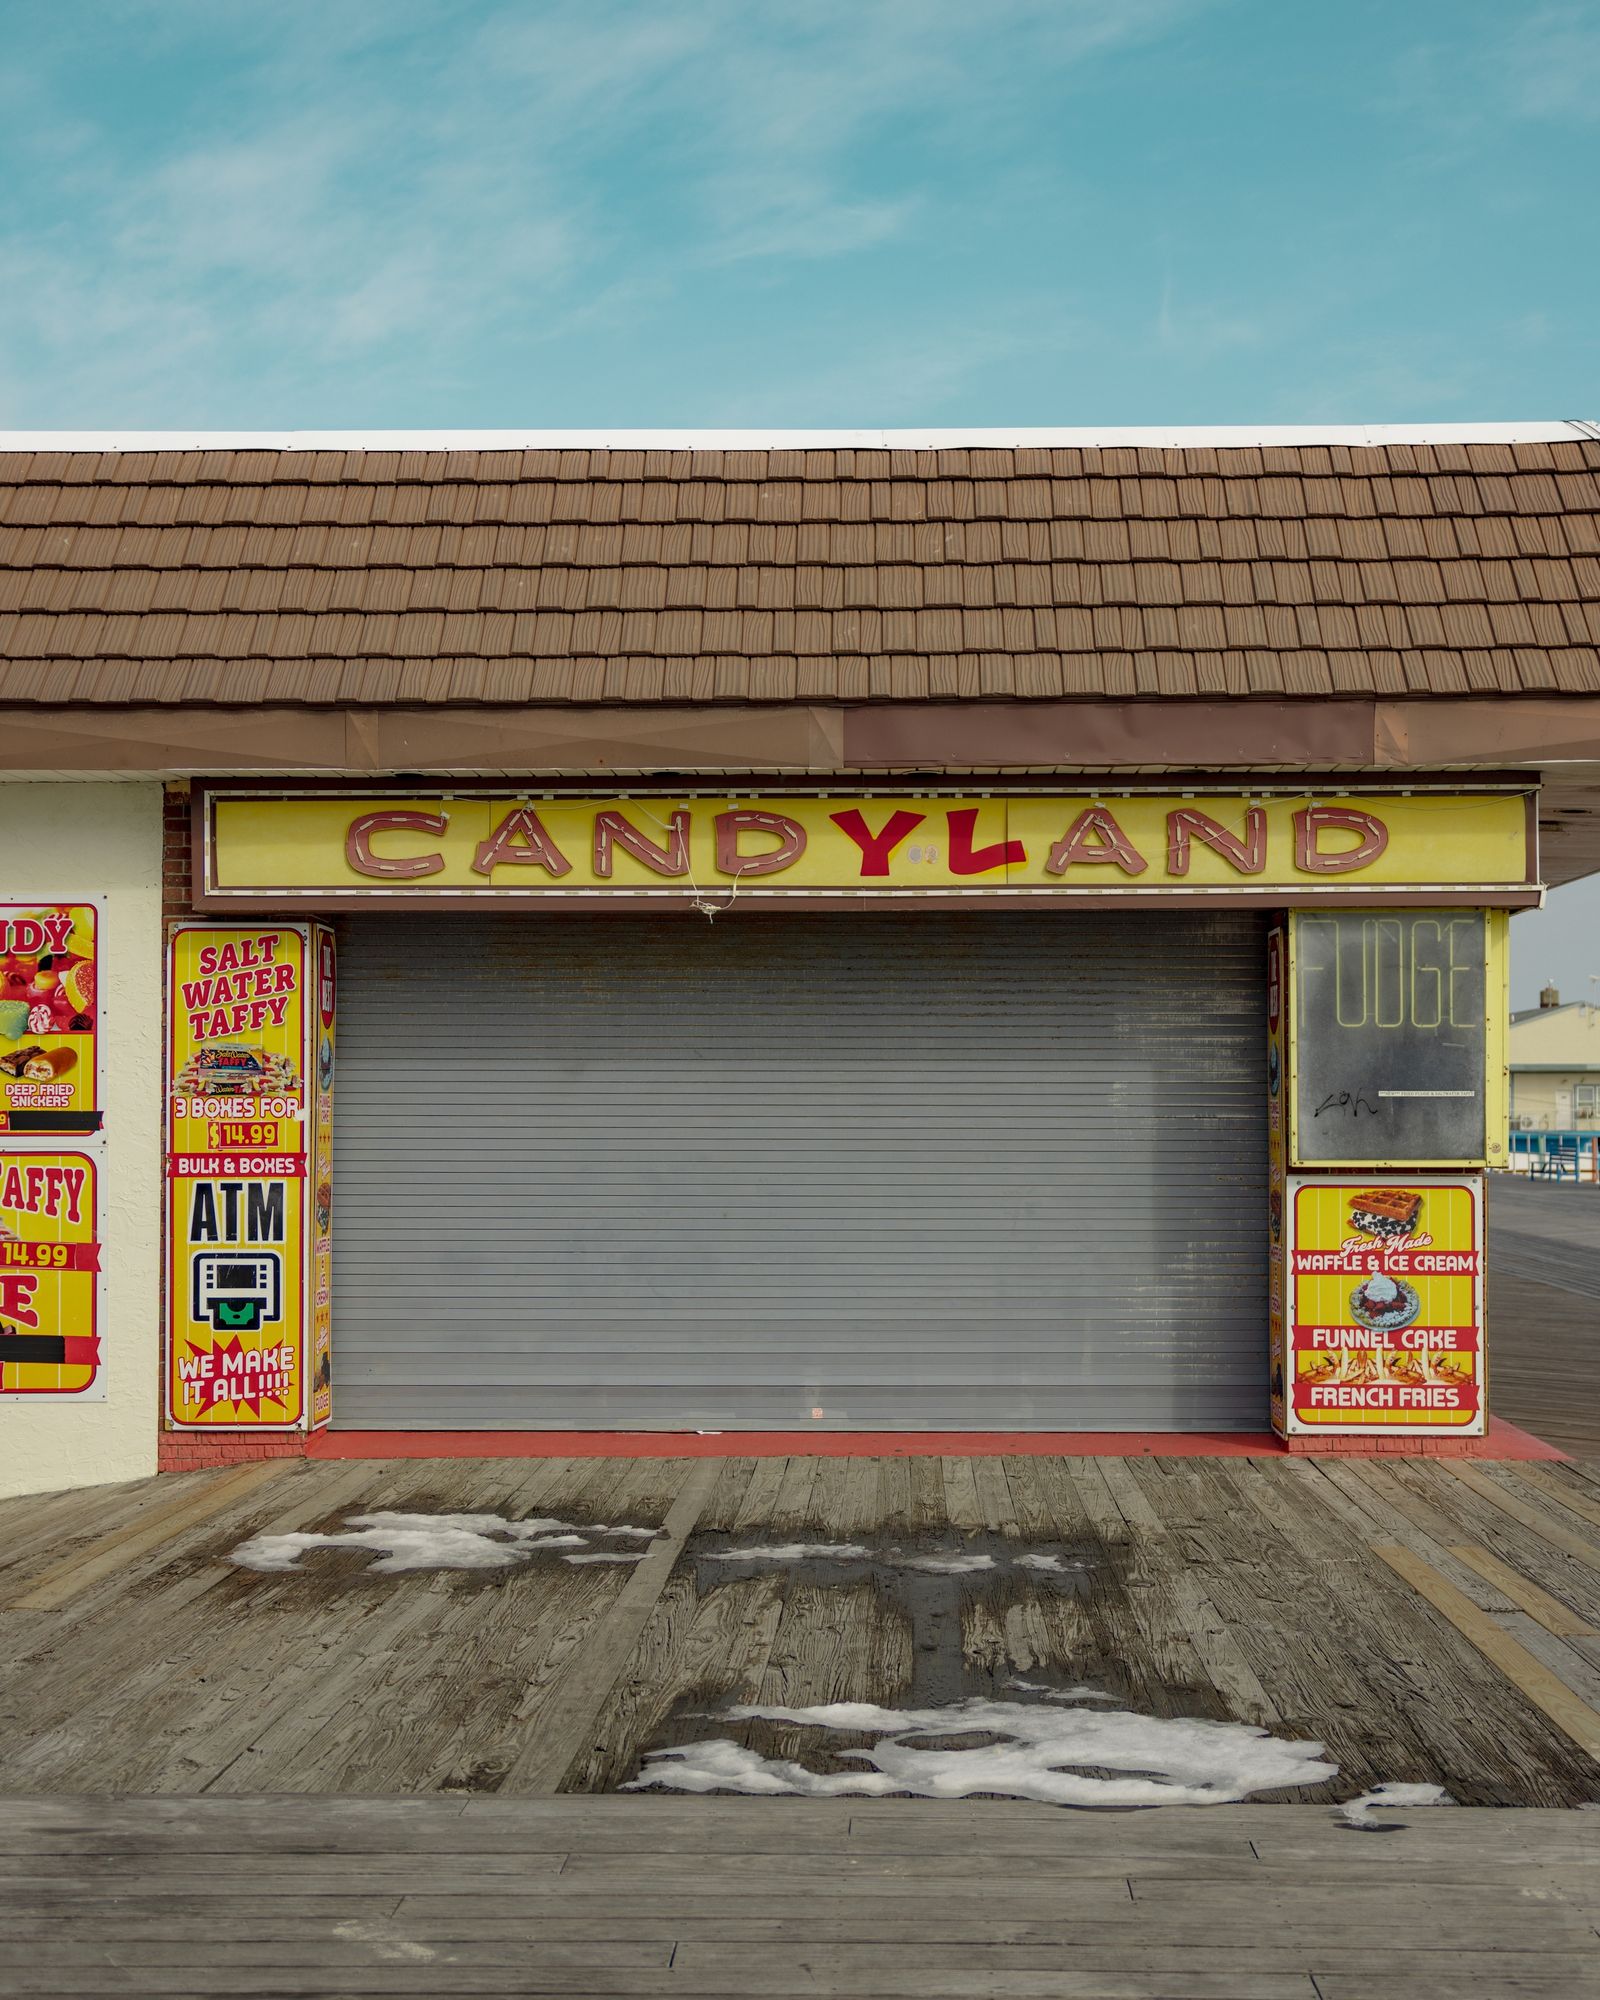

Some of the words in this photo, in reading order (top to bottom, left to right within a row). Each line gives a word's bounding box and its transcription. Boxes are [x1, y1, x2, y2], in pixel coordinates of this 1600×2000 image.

[345, 807, 1389, 879] CANDYLAND
[0, 919, 73, 954] DY
[199, 934, 279, 975] SALT
[181, 963, 296, 1010] WATER
[1301, 919, 1477, 1028] FUDGE
[189, 996, 288, 1040] TAFFY
[5, 1084, 37, 1096] DEEP
[40, 1084, 75, 1096] FRIED
[11, 1095, 70, 1107] SNICKERS
[175, 1097, 187, 1118] 3
[191, 1097, 256, 1118] BOXES
[260, 1097, 299, 1118] FOR
[178, 1158, 219, 1174] BULK
[223, 1158, 235, 1174] &
[240, 1158, 295, 1174] BOXES
[0, 1162, 84, 1223] AFFY
[189, 1181, 285, 1242] ATM
[2, 1242, 67, 1267] 14.99
[1341, 1235, 1382, 1257] Fresh
[1384, 1232, 1433, 1254] Made
[1297, 1254, 1362, 1271] WAFFLE
[1367, 1254, 1380, 1271] &
[1384, 1254, 1409, 1271] ICE
[1414, 1254, 1474, 1271] CREAM
[1312, 1329, 1394, 1348] FUNNEL
[1402, 1329, 1457, 1348] CAKE
[178, 1354, 215, 1380] WE
[222, 1346, 295, 1376] MAKE
[183, 1380, 205, 1405] IT
[213, 1372, 289, 1402] ALL!!!!
[1311, 1387, 1392, 1407] FRENCH
[1400, 1387, 1460, 1407] FRIES
